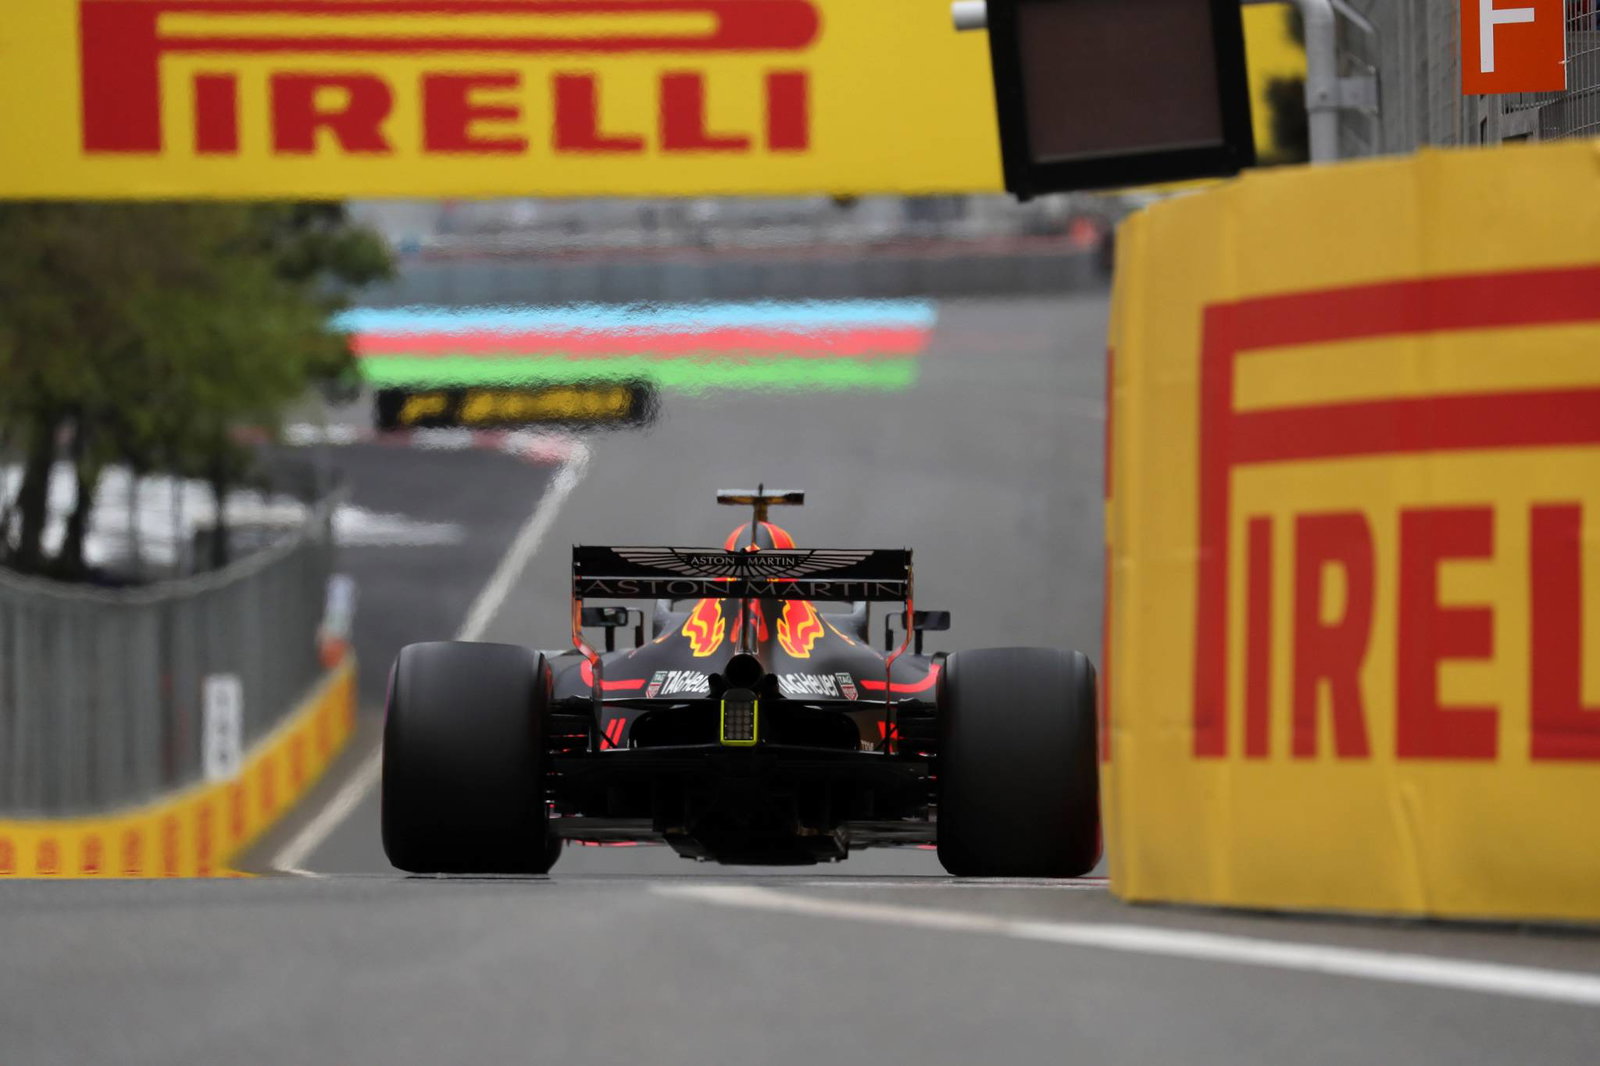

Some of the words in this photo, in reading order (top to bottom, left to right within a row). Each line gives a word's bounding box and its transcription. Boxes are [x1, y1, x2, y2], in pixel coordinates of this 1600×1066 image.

[78, 0, 821, 154] PIRELLI
[690, 556, 735, 565] ASTON
[747, 556, 795, 566] MARTIN
[584, 579, 730, 594] ASTON
[745, 581, 903, 596] MARTIN
